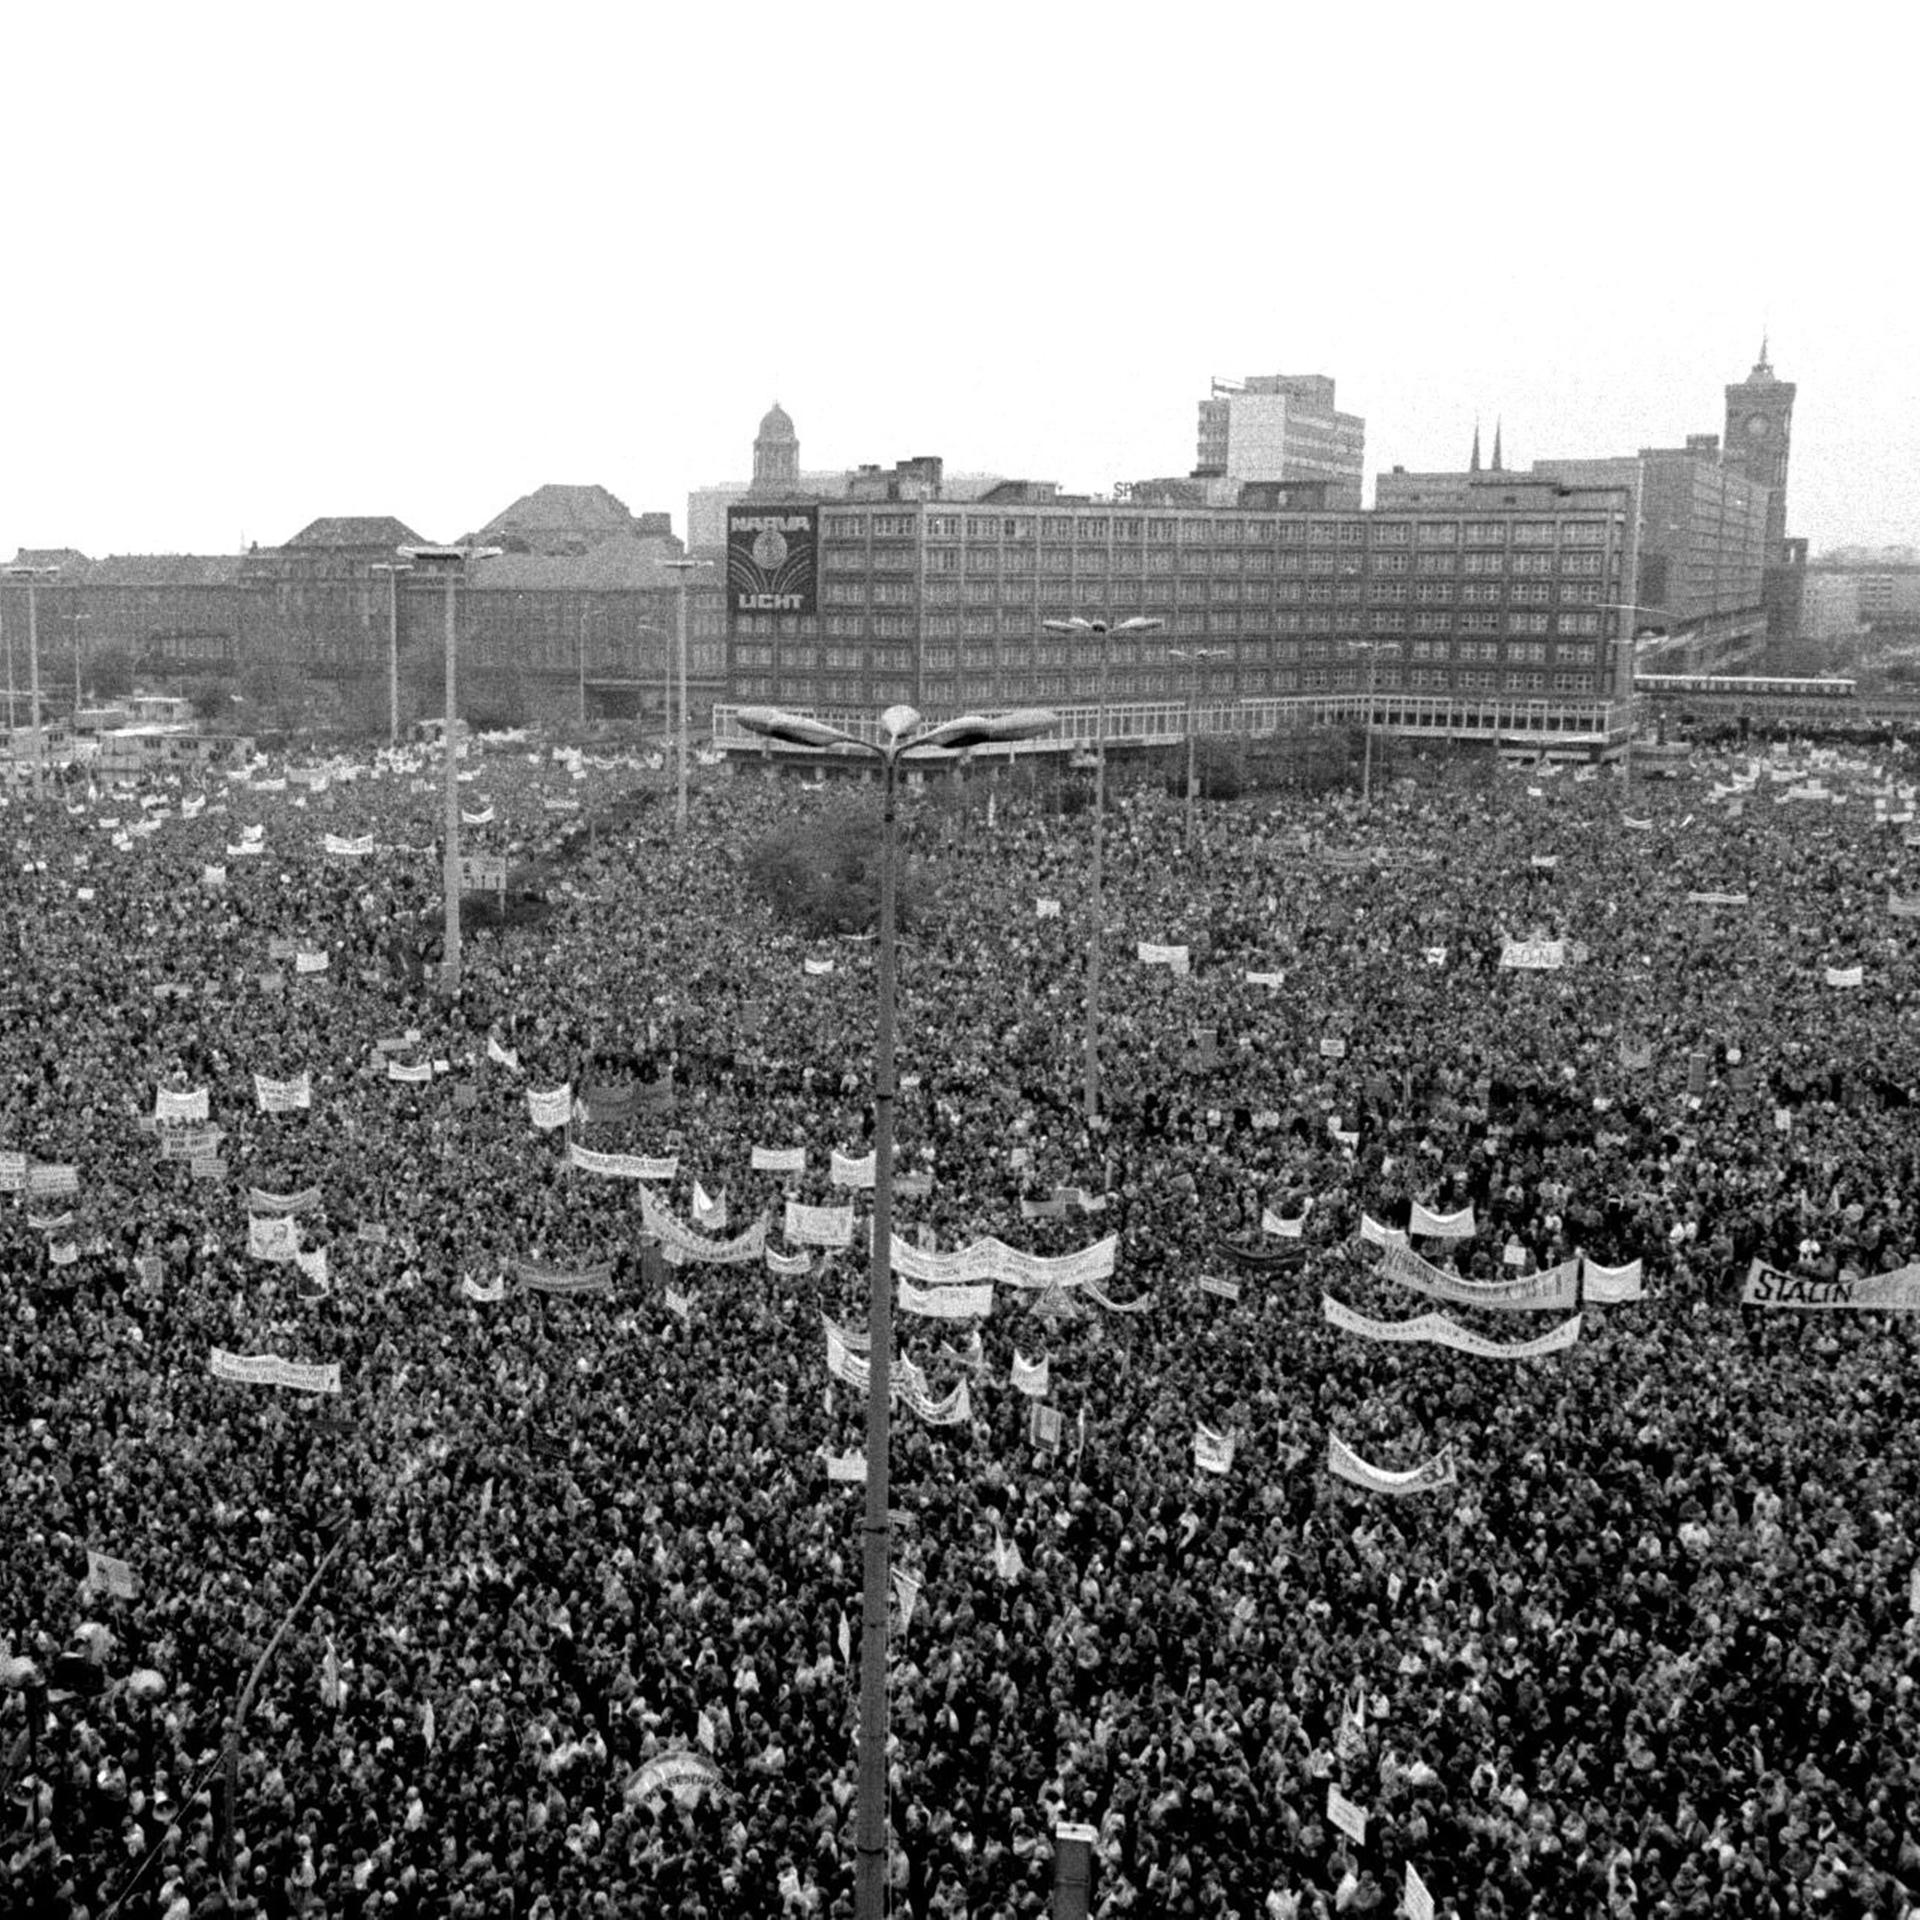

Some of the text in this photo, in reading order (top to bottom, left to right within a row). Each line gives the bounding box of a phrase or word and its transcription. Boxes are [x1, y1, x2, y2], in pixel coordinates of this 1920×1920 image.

[731, 516, 810, 531] NARVA
[739, 593, 804, 608] LICHT
[1754, 1268, 1852, 1303] STALIN
